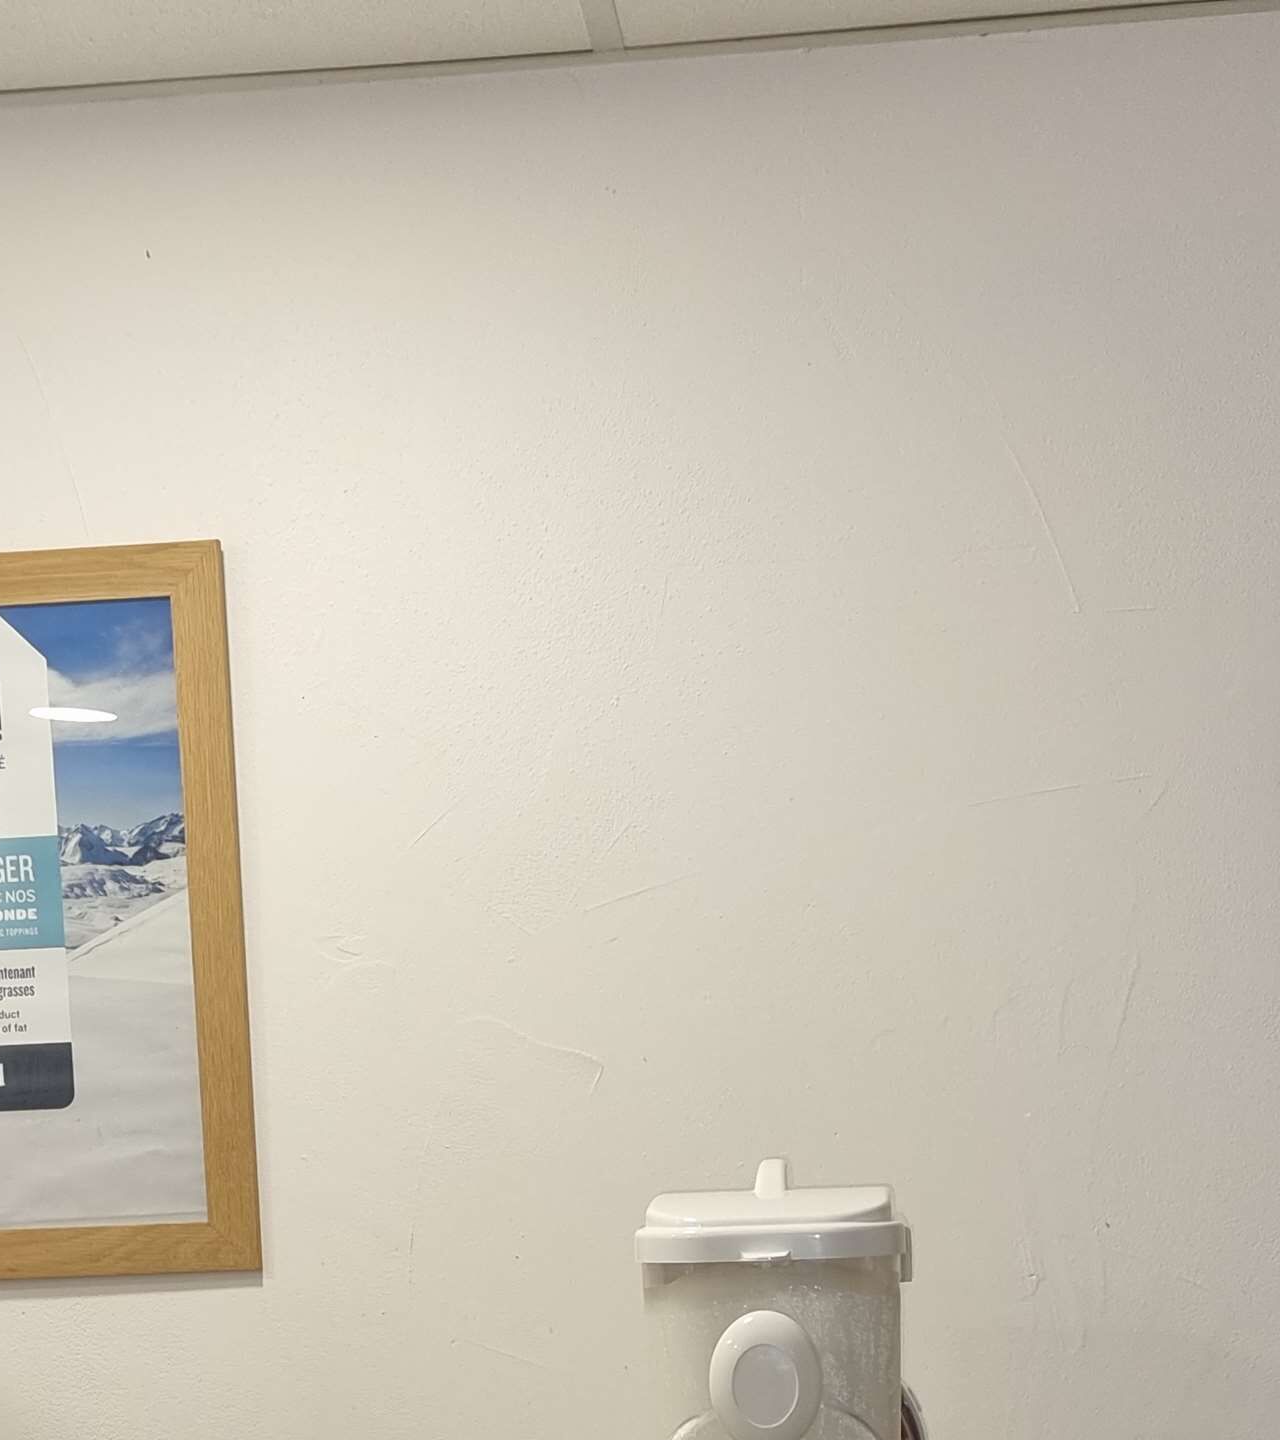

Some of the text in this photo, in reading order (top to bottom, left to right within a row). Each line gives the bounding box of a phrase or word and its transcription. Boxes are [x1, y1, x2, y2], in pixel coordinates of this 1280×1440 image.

[5, 889, 36, 903] NOS
[5, 927, 38, 937] TOPPINGS
[2, 1023, 12, 1033] of
[14, 1022, 28, 1032] fat
